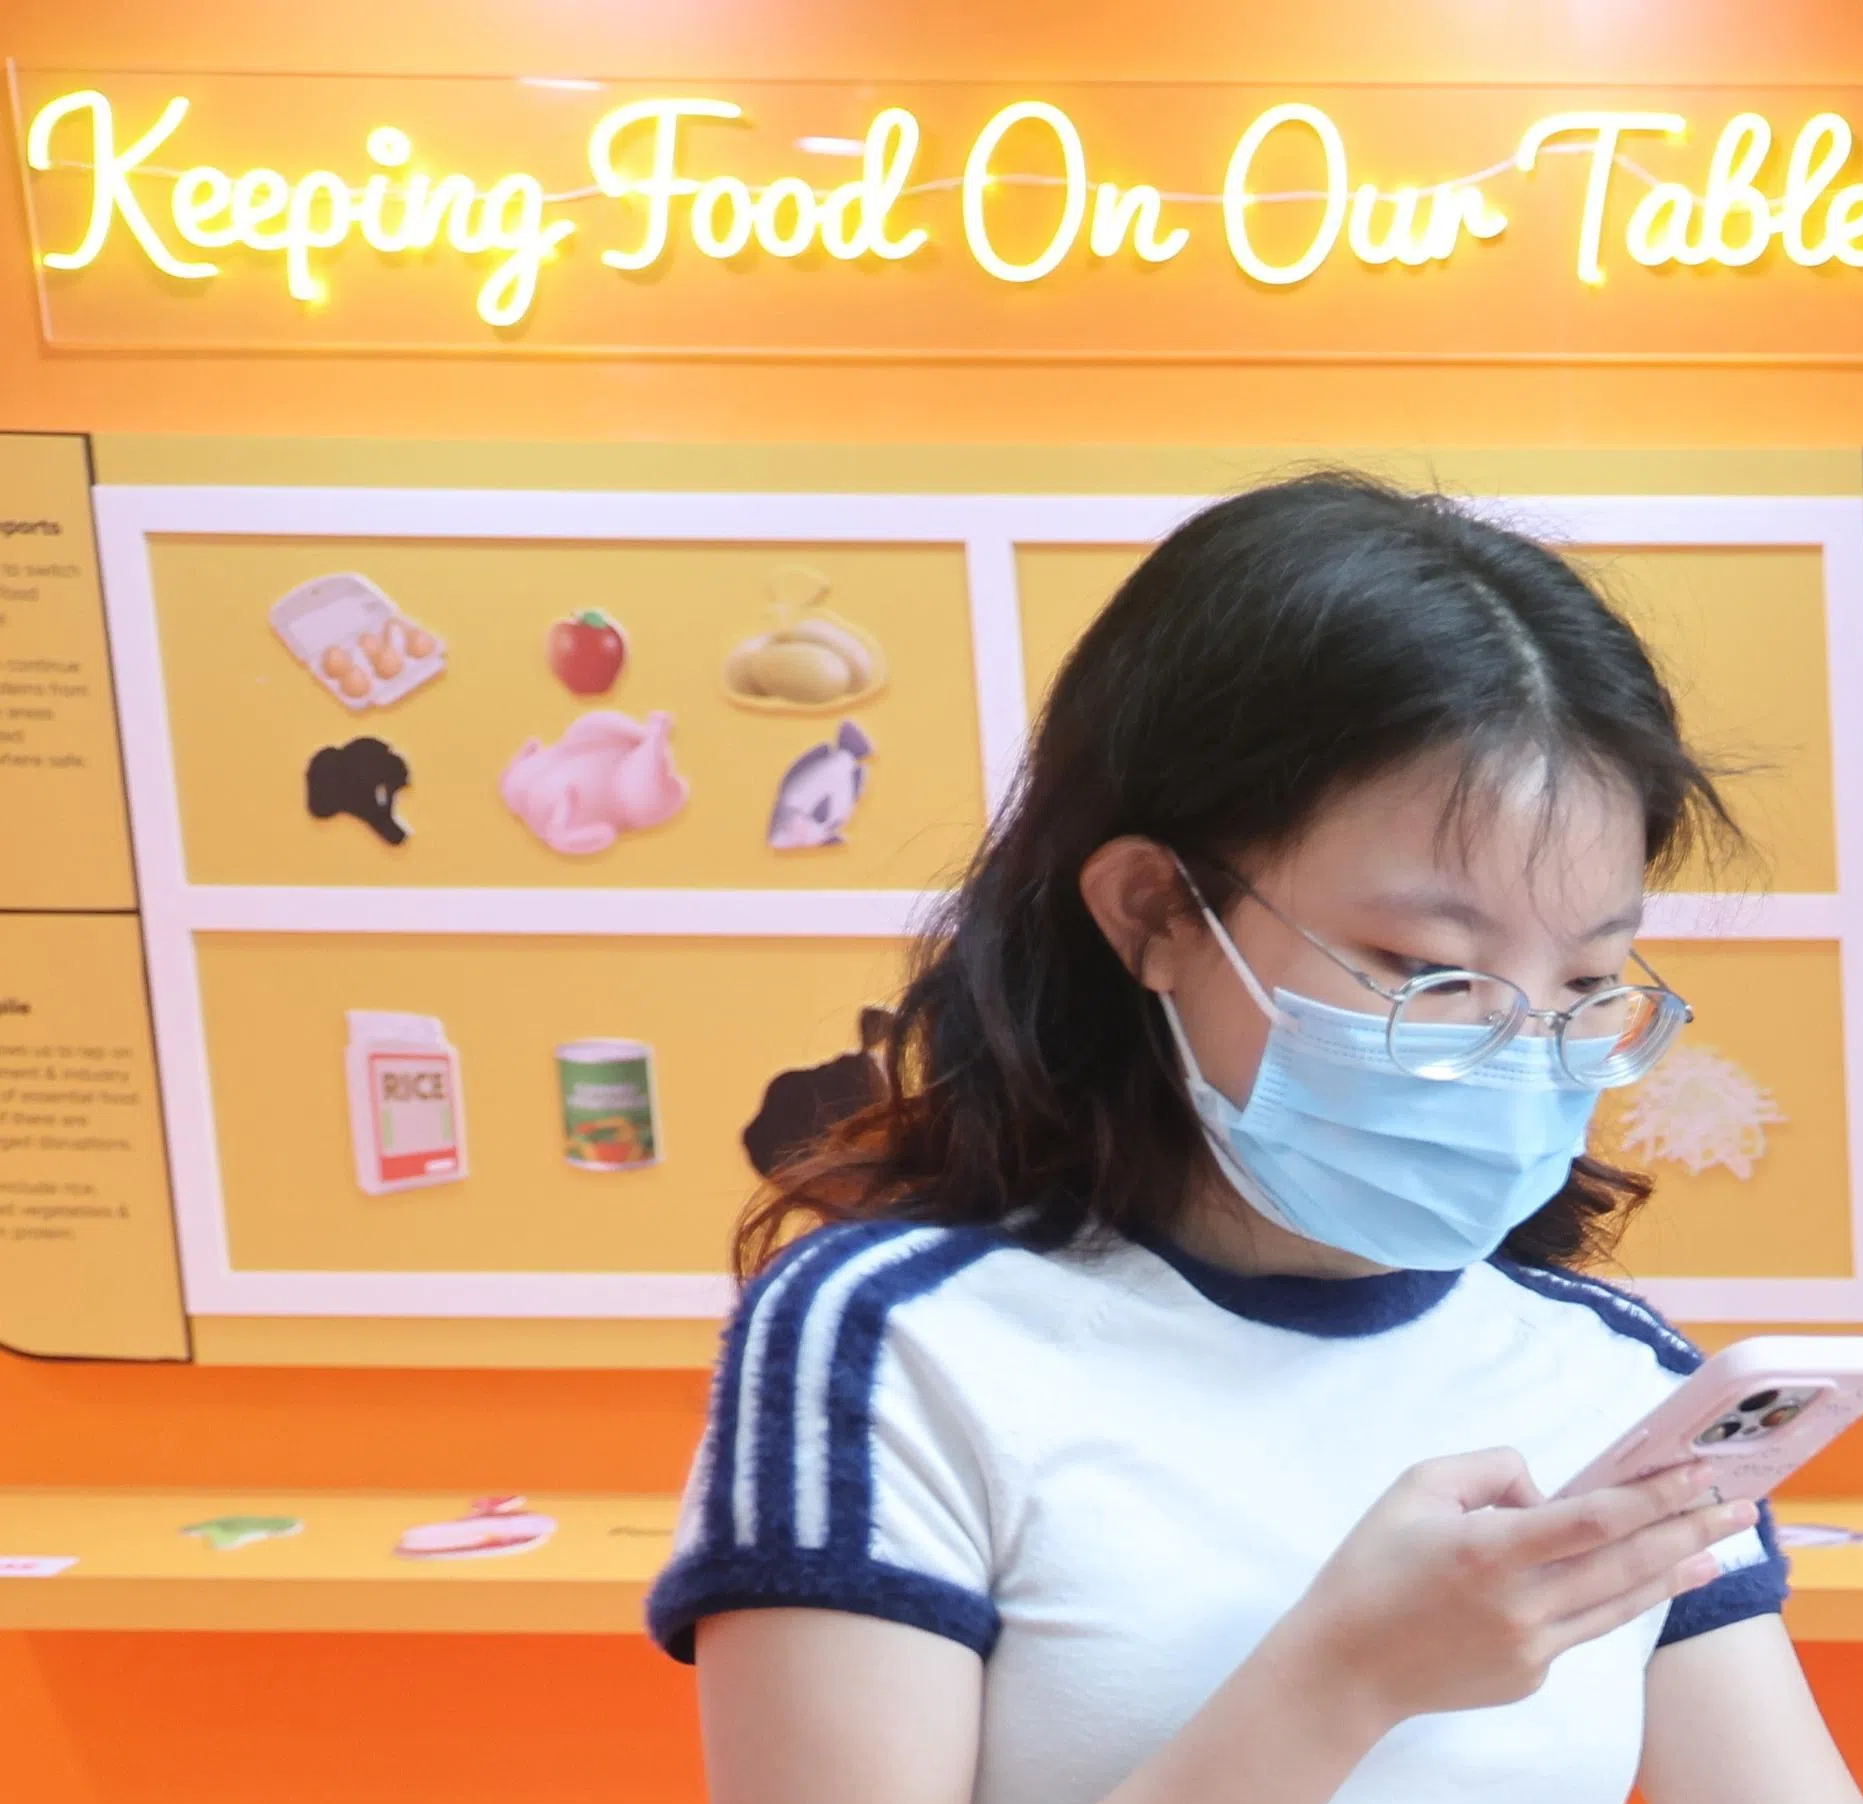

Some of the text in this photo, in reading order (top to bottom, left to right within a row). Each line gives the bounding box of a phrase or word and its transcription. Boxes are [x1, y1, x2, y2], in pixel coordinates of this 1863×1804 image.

[26, 88, 576, 328] Keeping
[588, 98, 930, 272] Food
[960, 100, 1190, 283] On
[1222, 102, 1506, 285] Our
[0, 520, 61, 538] ports
[383, 1072, 445, 1101] RICE
